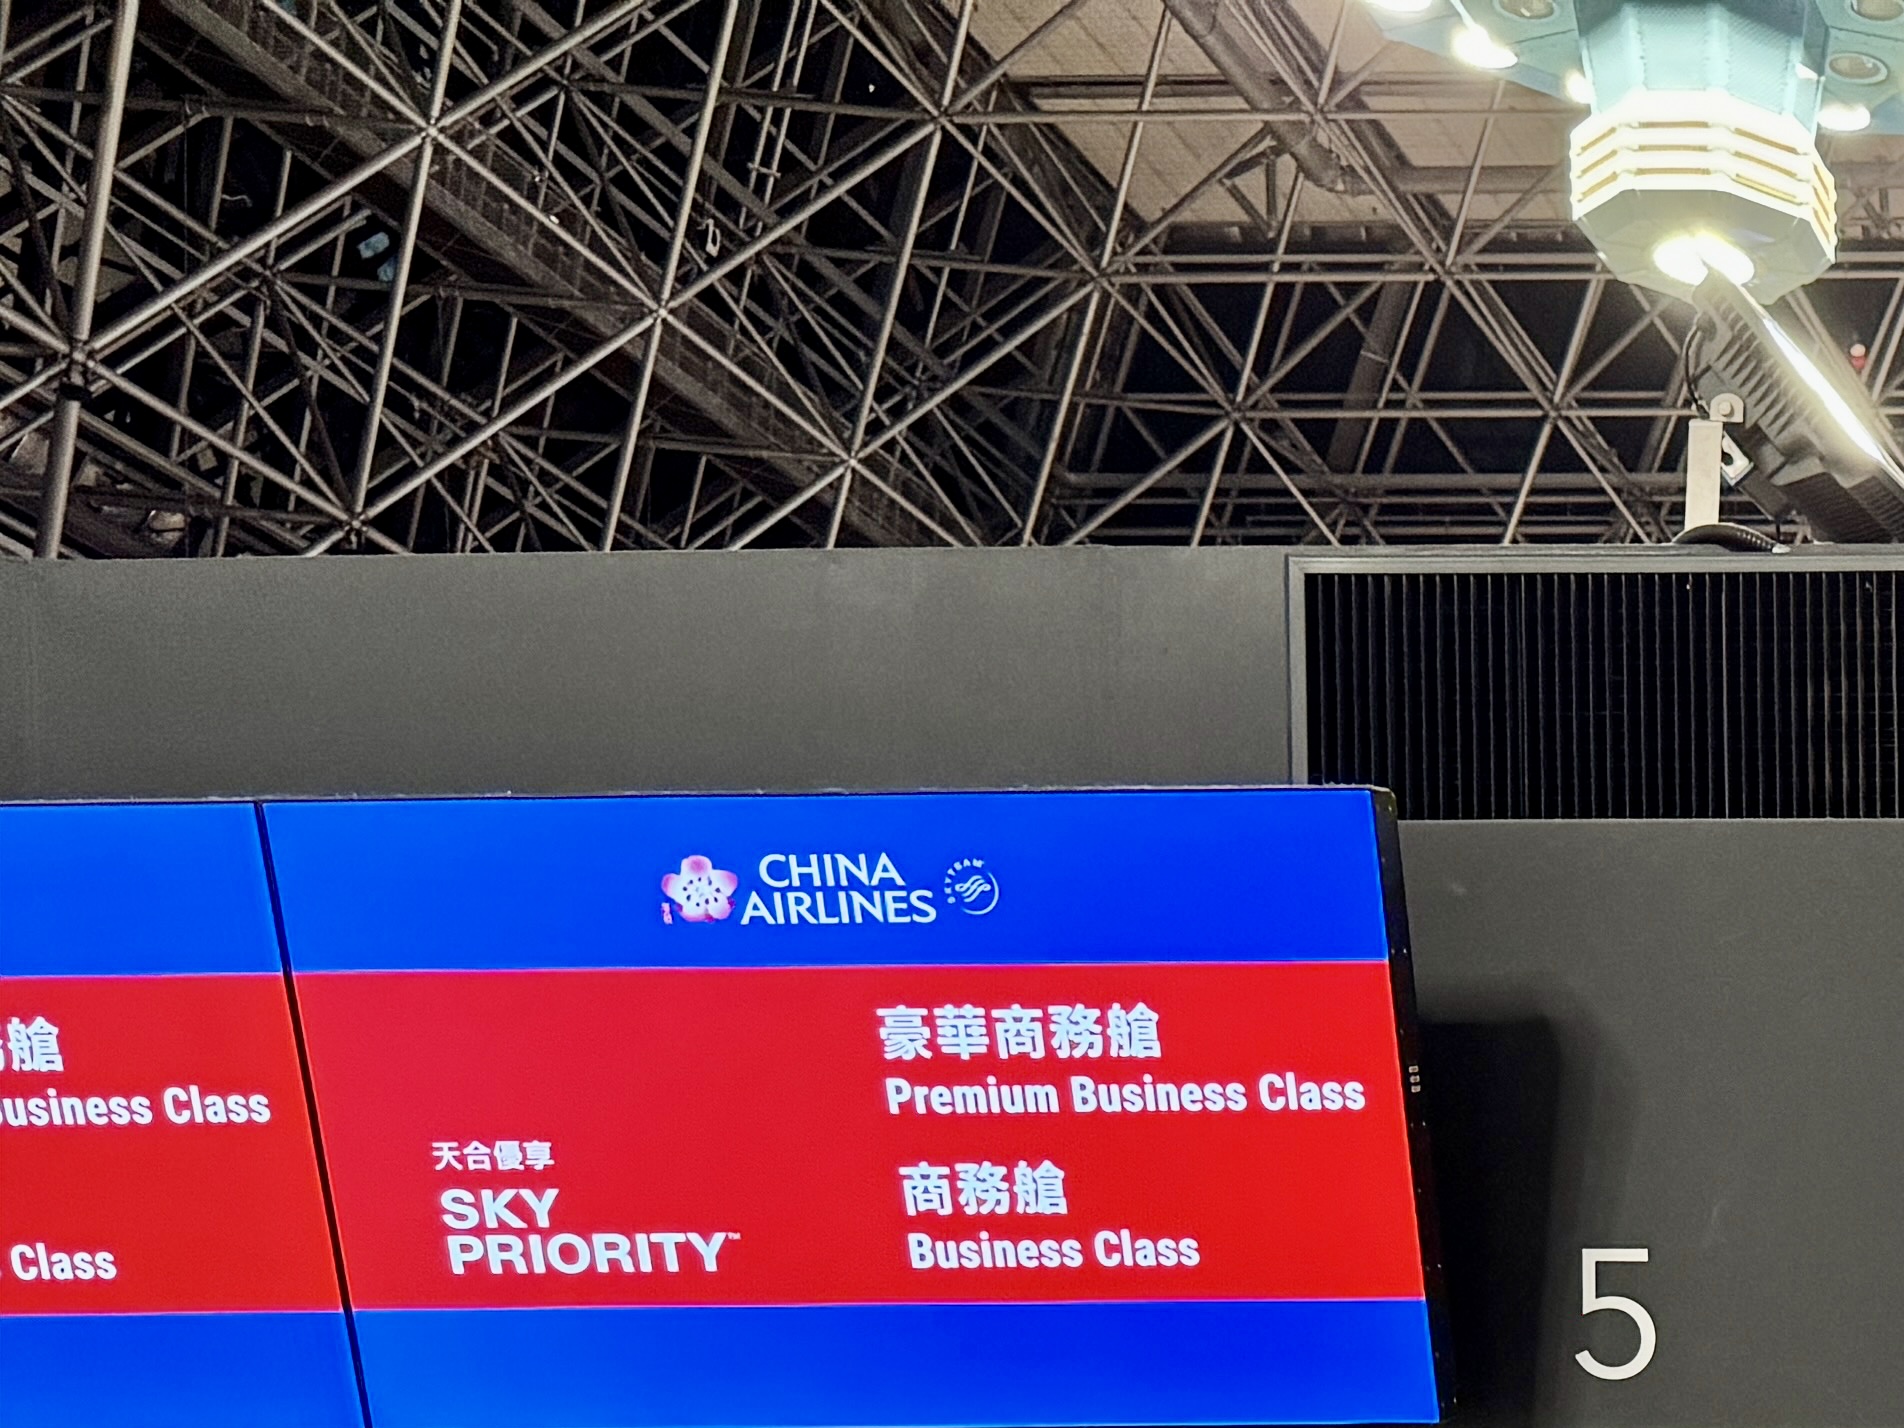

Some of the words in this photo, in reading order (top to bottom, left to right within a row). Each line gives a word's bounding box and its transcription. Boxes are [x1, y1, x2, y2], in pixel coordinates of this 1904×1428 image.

[759, 852, 906, 888] CHINA
[740, 889, 937, 925] AIRLINES
[0, 1015, 65, 1073] 艙
[875, 1001, 1162, 1061] 豪華商務艙
[163, 1084, 271, 1125] Class
[885, 1075, 1060, 1115] Premium
[1070, 1073, 1248, 1113] Business
[1258, 1071, 1366, 1112] Class
[431, 1139, 555, 1171] 天合優享
[898, 1159, 1068, 1217] 商務艙
[440, 1188, 560, 1230] SKY
[10, 1242, 118, 1281] Class
[907, 1230, 1084, 1269] Business
[1093, 1228, 1201, 1267] Class
[1574, 1247, 1657, 1381] 5
